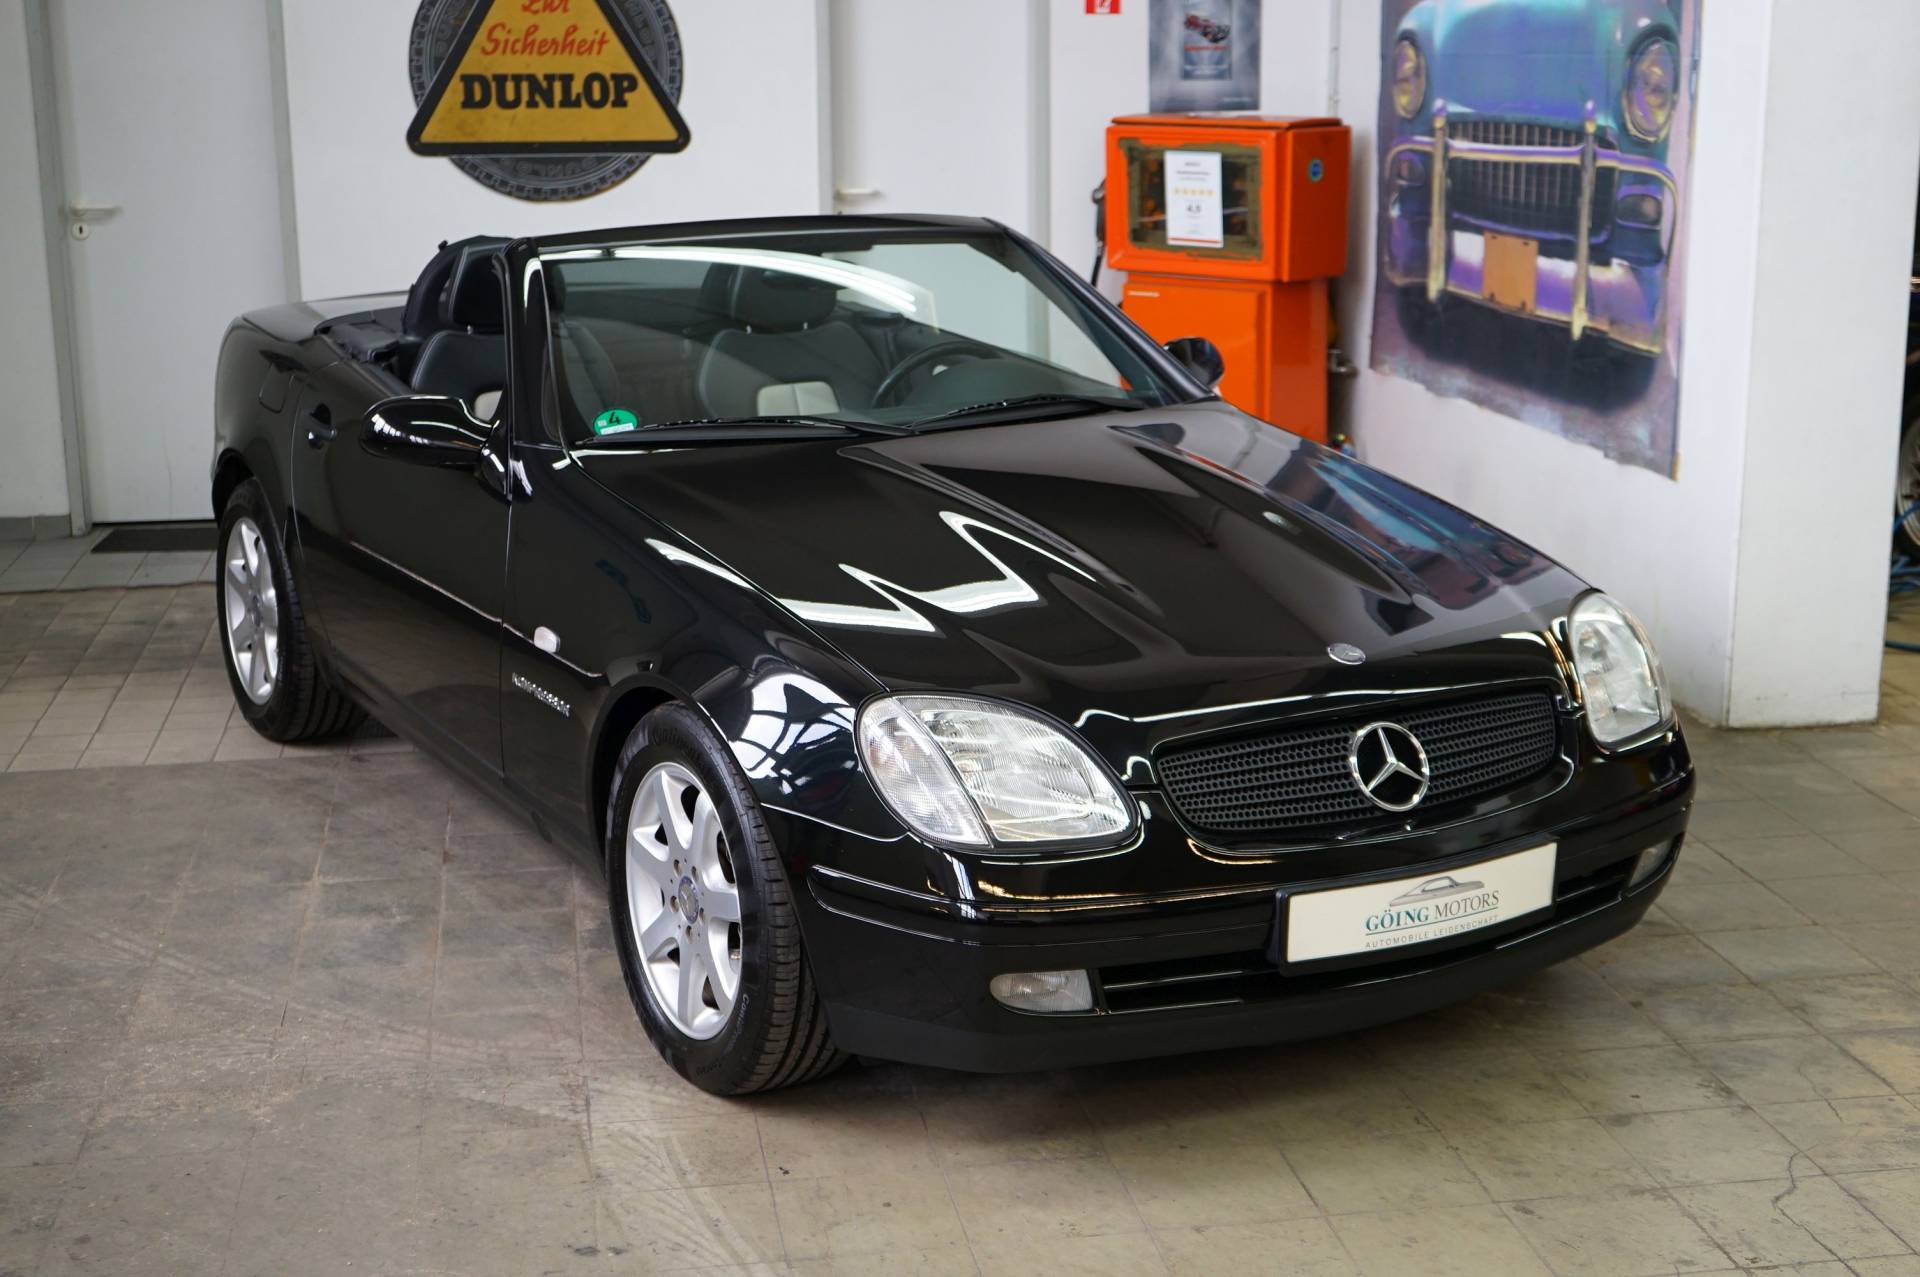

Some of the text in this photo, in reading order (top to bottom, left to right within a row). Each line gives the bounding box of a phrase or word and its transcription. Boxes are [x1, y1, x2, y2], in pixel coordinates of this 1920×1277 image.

[481, 22, 609, 56] Sicherheit
[459, 72, 639, 110] DUNLOP
[609, 411, 620, 424] 4
[1366, 890, 1500, 932] GÖING MOTORS
[1366, 915, 1498, 948] AUTOMOBILE LEIDENSCHAFT
